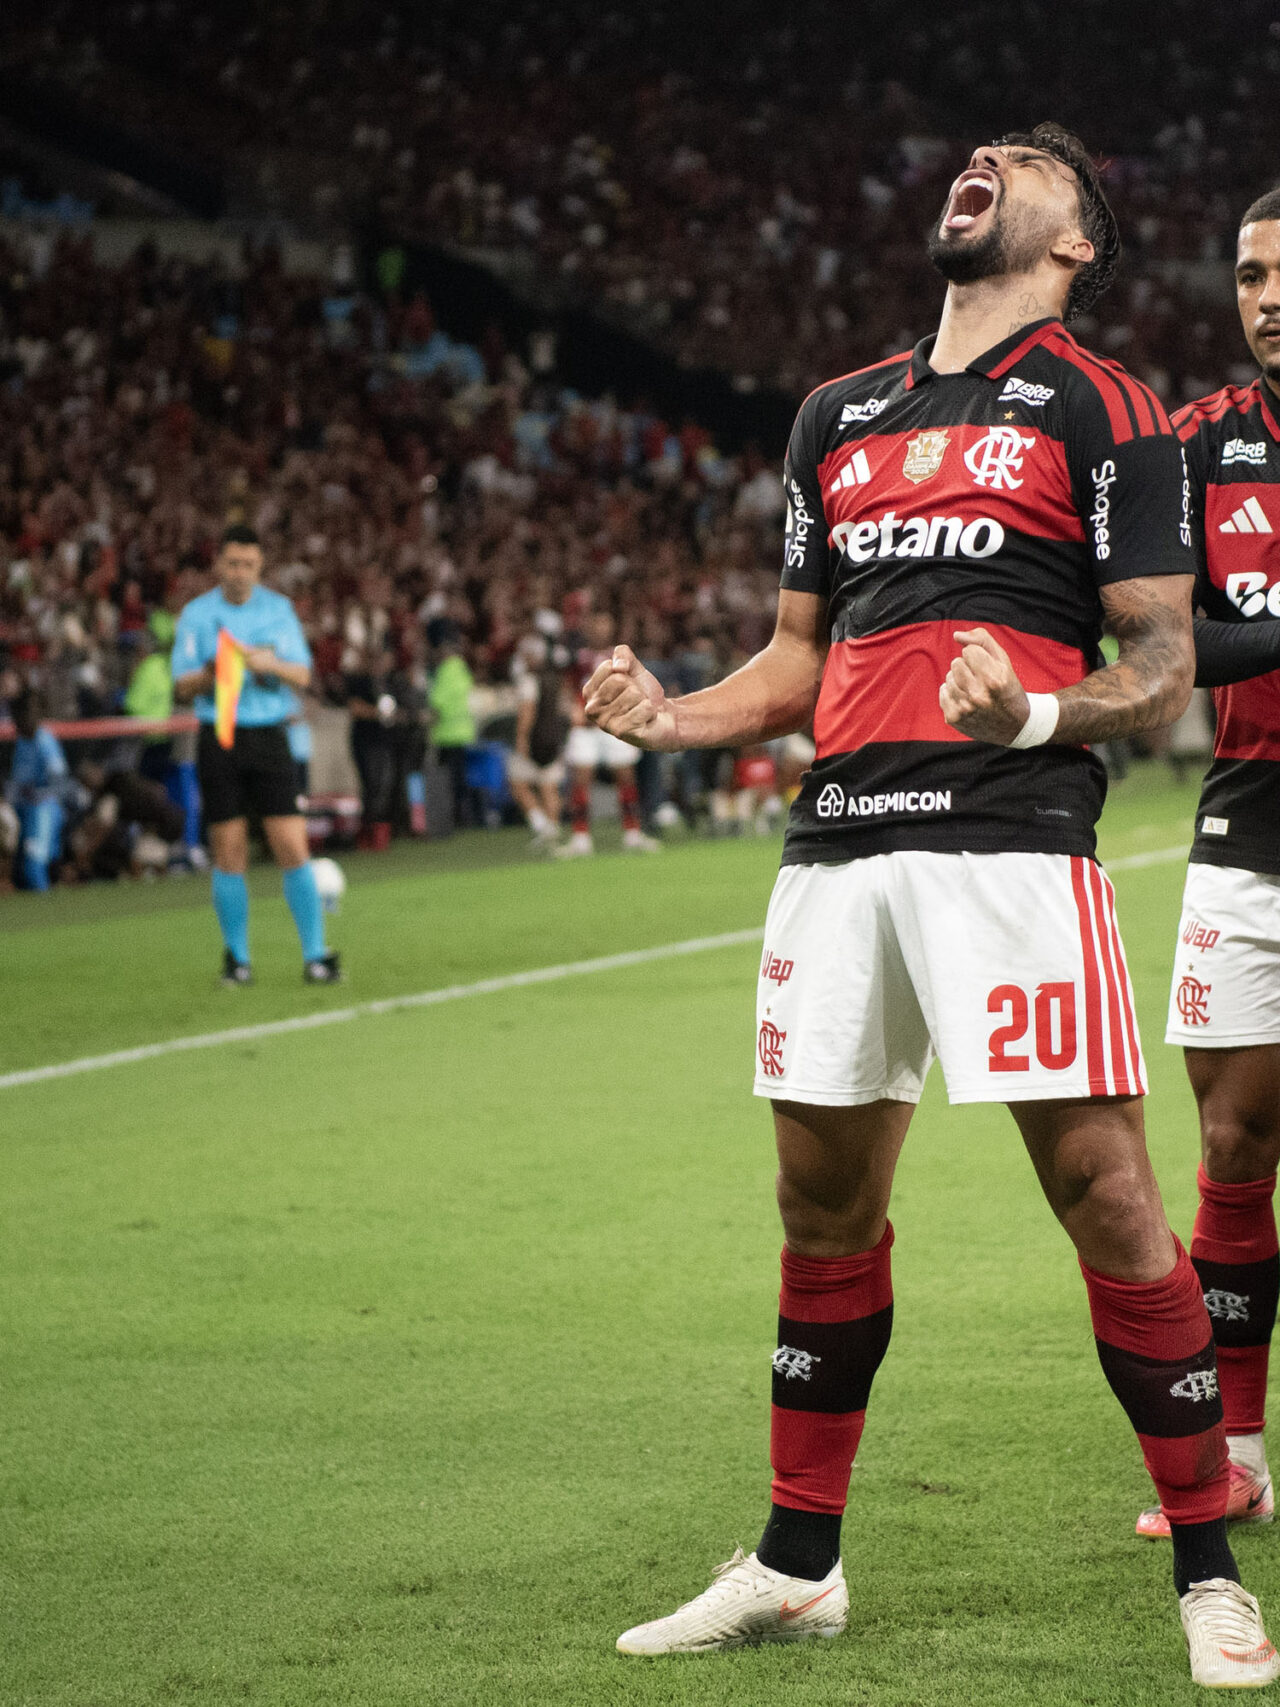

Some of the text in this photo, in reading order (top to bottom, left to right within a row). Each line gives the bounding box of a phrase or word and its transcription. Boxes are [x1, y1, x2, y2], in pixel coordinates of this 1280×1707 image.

[1017, 384, 1055, 401] BRB
[1236, 438, 1267, 458] BRB
[787, 478, 814, 568] Shopee
[1091, 458, 1117, 561] Shopee
[847, 790, 951, 816] ADEMICON
[1182, 920, 1220, 953] Wap
[762, 950, 794, 987] Wap
[987, 981, 1078, 1073] 20
